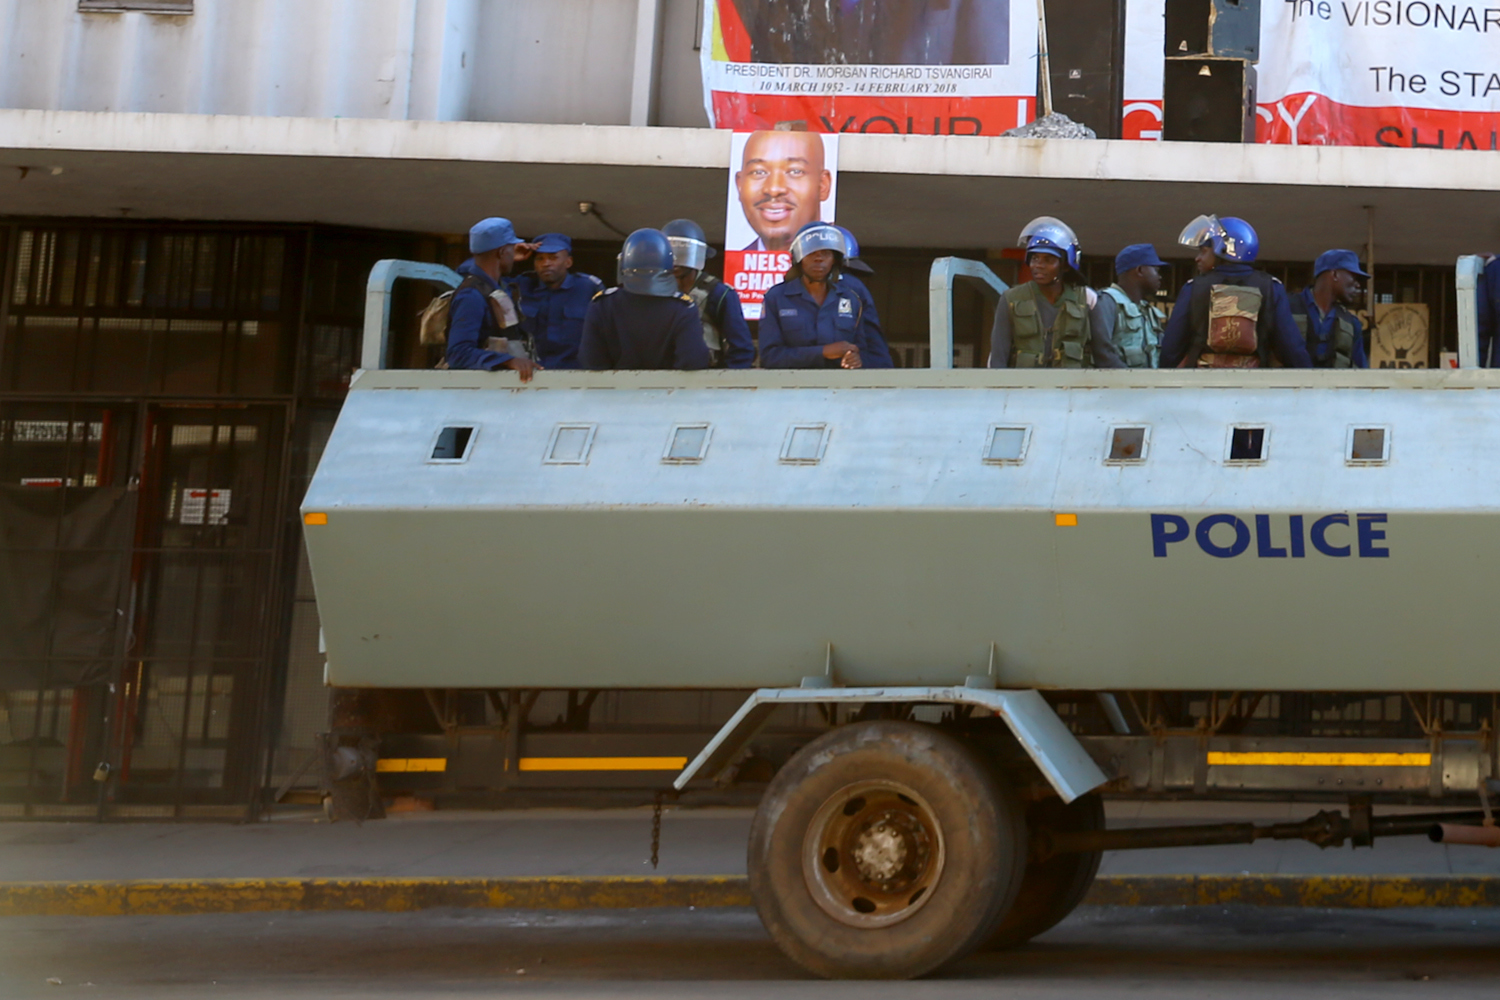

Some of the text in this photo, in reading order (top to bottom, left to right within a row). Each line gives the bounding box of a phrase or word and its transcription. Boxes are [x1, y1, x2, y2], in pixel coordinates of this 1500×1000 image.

[725, 64, 992, 80] PRESIDENT DR. MORGAN RICHARD TSVANGIRAI
[1369, 66, 1427, 94] The
[759, 81, 772, 91] 10
[773, 81, 818, 92] MARCH
[820, 82, 844, 93] 1952
[853, 83, 866, 93] 14
[868, 83, 932, 94] FEBRUARY
[933, 84, 957, 94] 2018
[744, 253, 792, 271] NELS
[1150, 513, 1390, 559] POLICE
